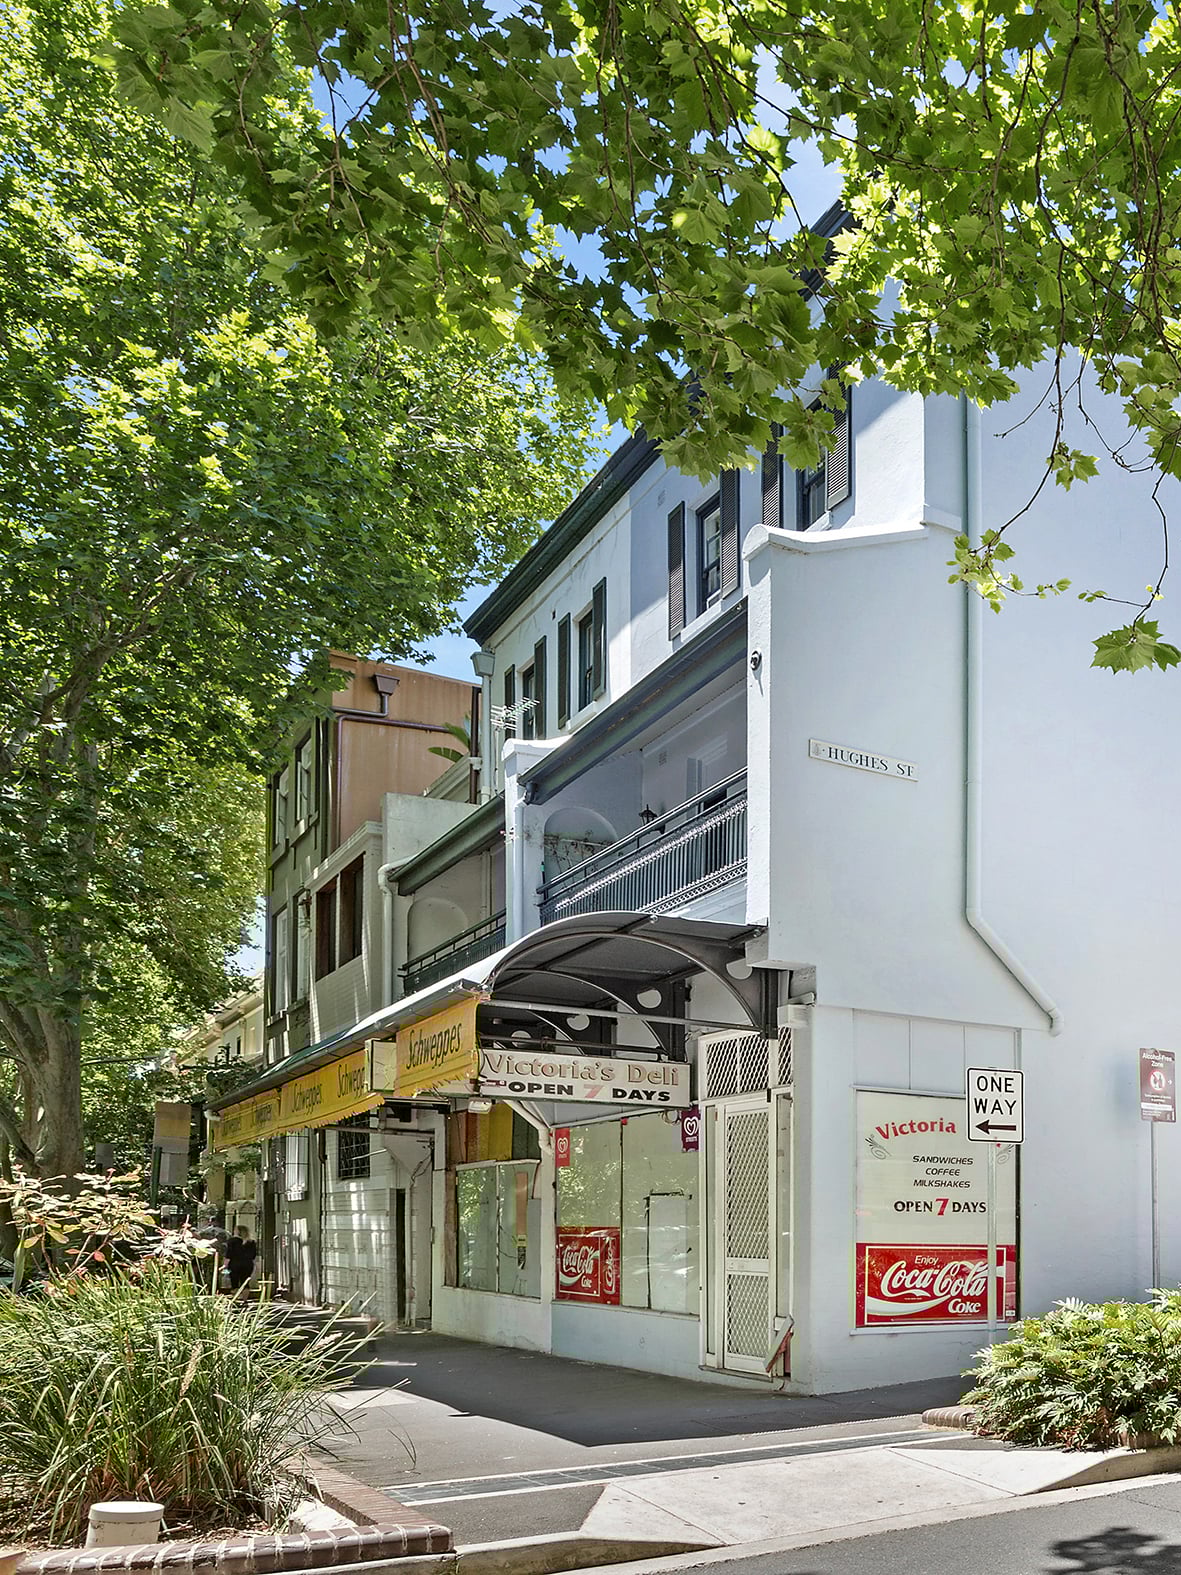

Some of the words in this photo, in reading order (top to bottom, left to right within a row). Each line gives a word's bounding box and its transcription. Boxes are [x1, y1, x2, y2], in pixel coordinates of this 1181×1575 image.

[828, 747, 888, 771] HUGHES
[896, 763, 914, 776] ST
[406, 1021, 462, 1070] Schweppes
[483, 1053, 615, 1082] Victoria's
[627, 1064, 679, 1086] Deli
[508, 1081, 574, 1096] OPEN
[583, 1083, 605, 1099] 7
[611, 1088, 670, 1102] DAYS
[976, 1075, 1015, 1093] ONE
[974, 1097, 1017, 1115] WAY
[875, 1117, 957, 1140] Victoria
[912, 1155, 974, 1165] SANDWICHES
[925, 1167, 960, 1177] COFFEE
[913, 1179, 971, 1189] MILKSHAKES
[894, 1200, 933, 1213] OPEN
[935, 1198, 949, 1216] 7
[952, 1201, 987, 1213] DAYS
[914, 1255, 939, 1265] Enjoy
[880, 1260, 988, 1298] Coca-Cola
[947, 1298, 982, 1314] Coke
